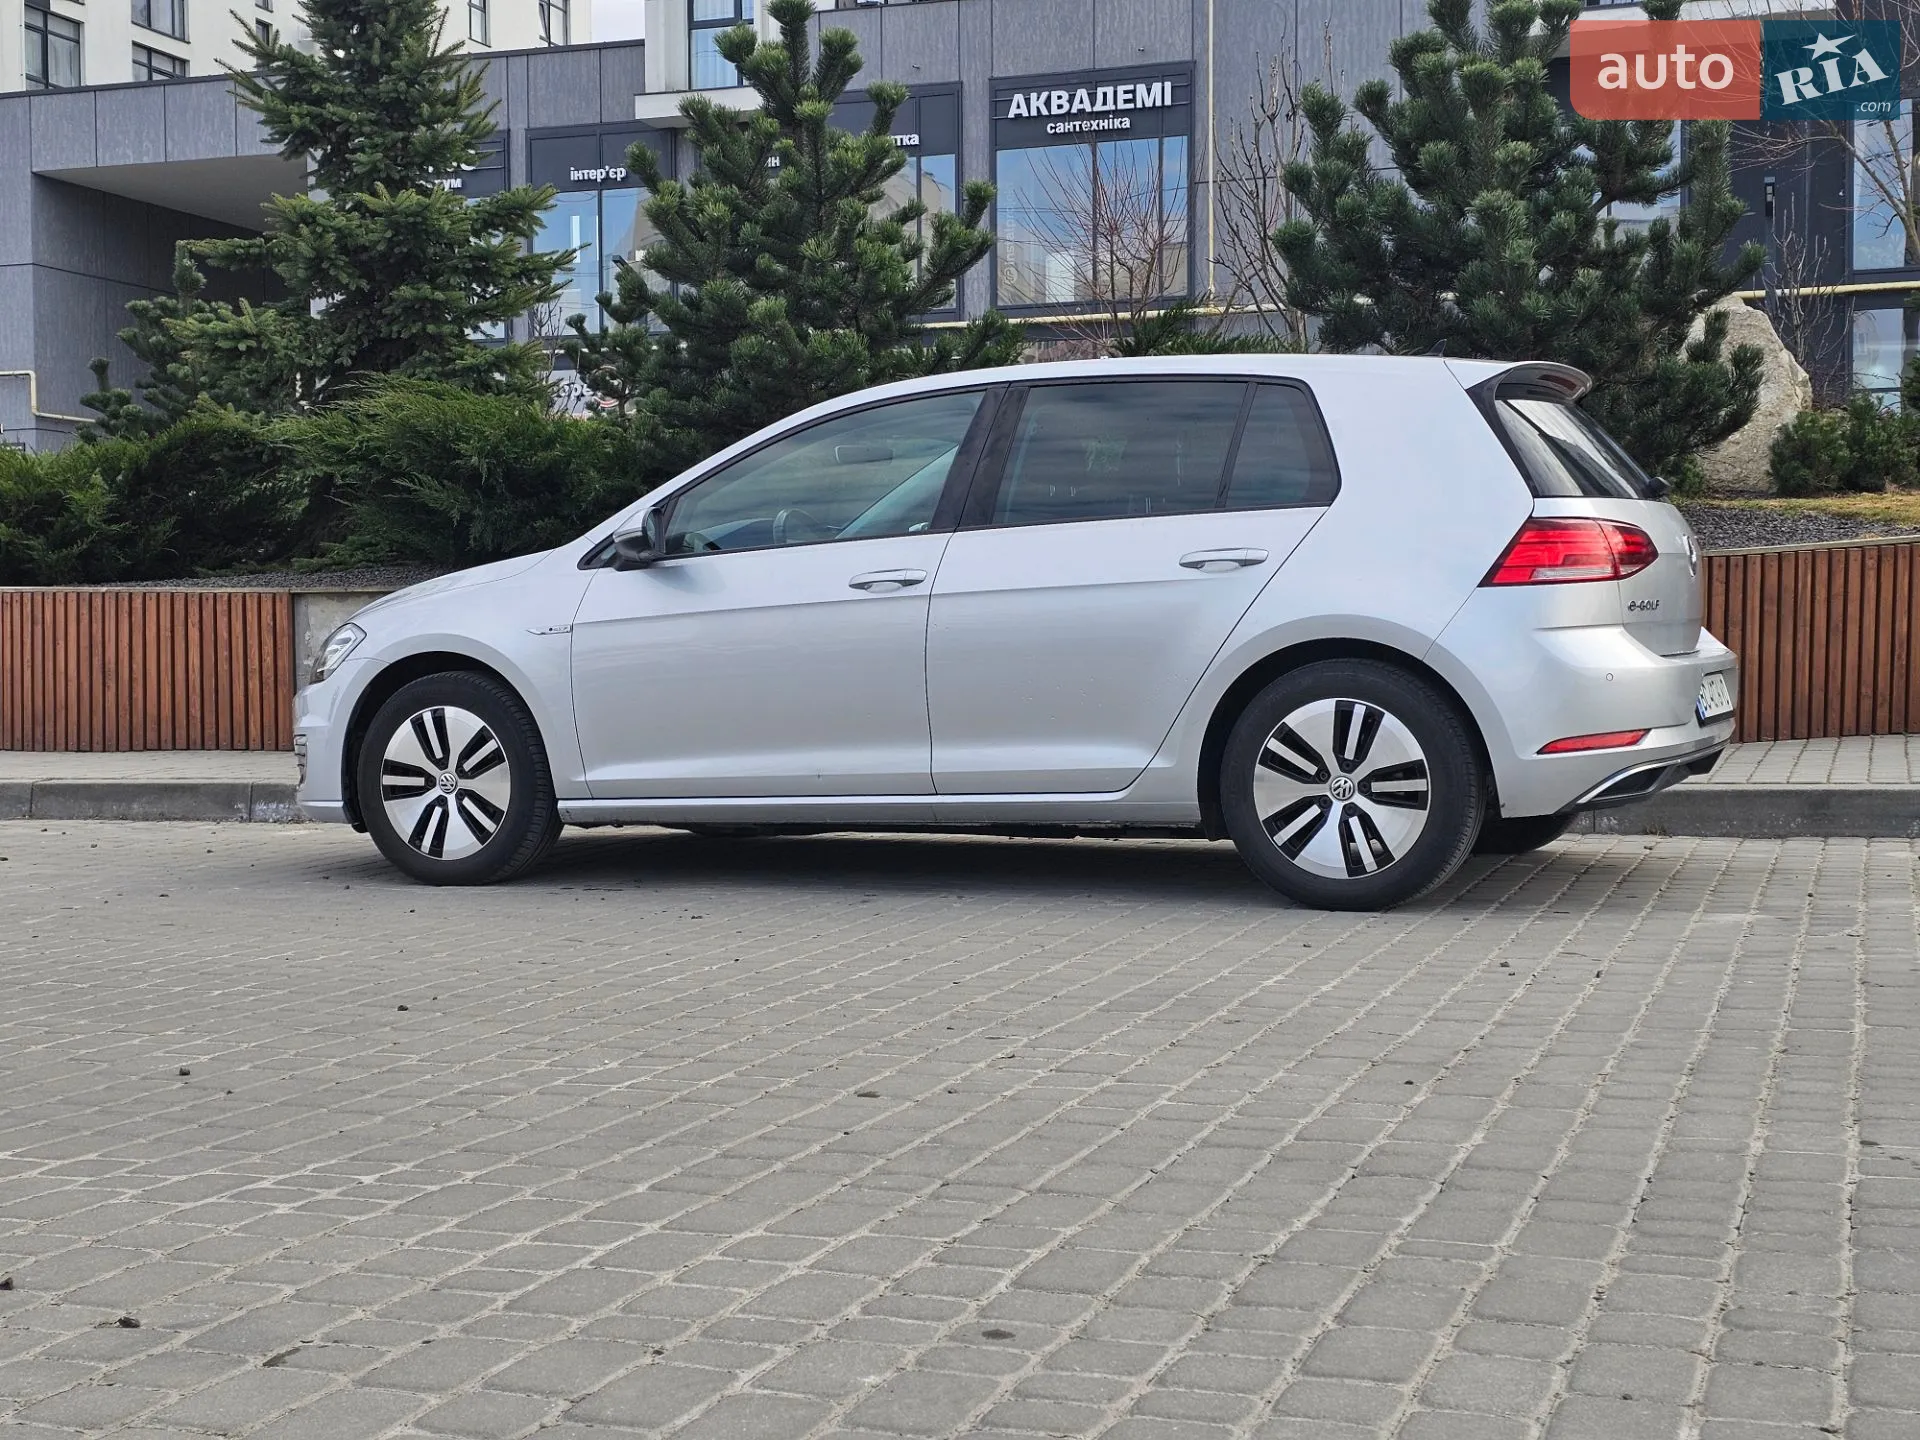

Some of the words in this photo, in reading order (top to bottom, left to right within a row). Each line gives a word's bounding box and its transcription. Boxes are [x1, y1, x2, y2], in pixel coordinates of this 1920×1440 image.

[1007, 81, 1172, 119] АКВАДЕМІ
[1046, 115, 1131, 134] сантехніка
[569, 165, 627, 183] інтер'єр
